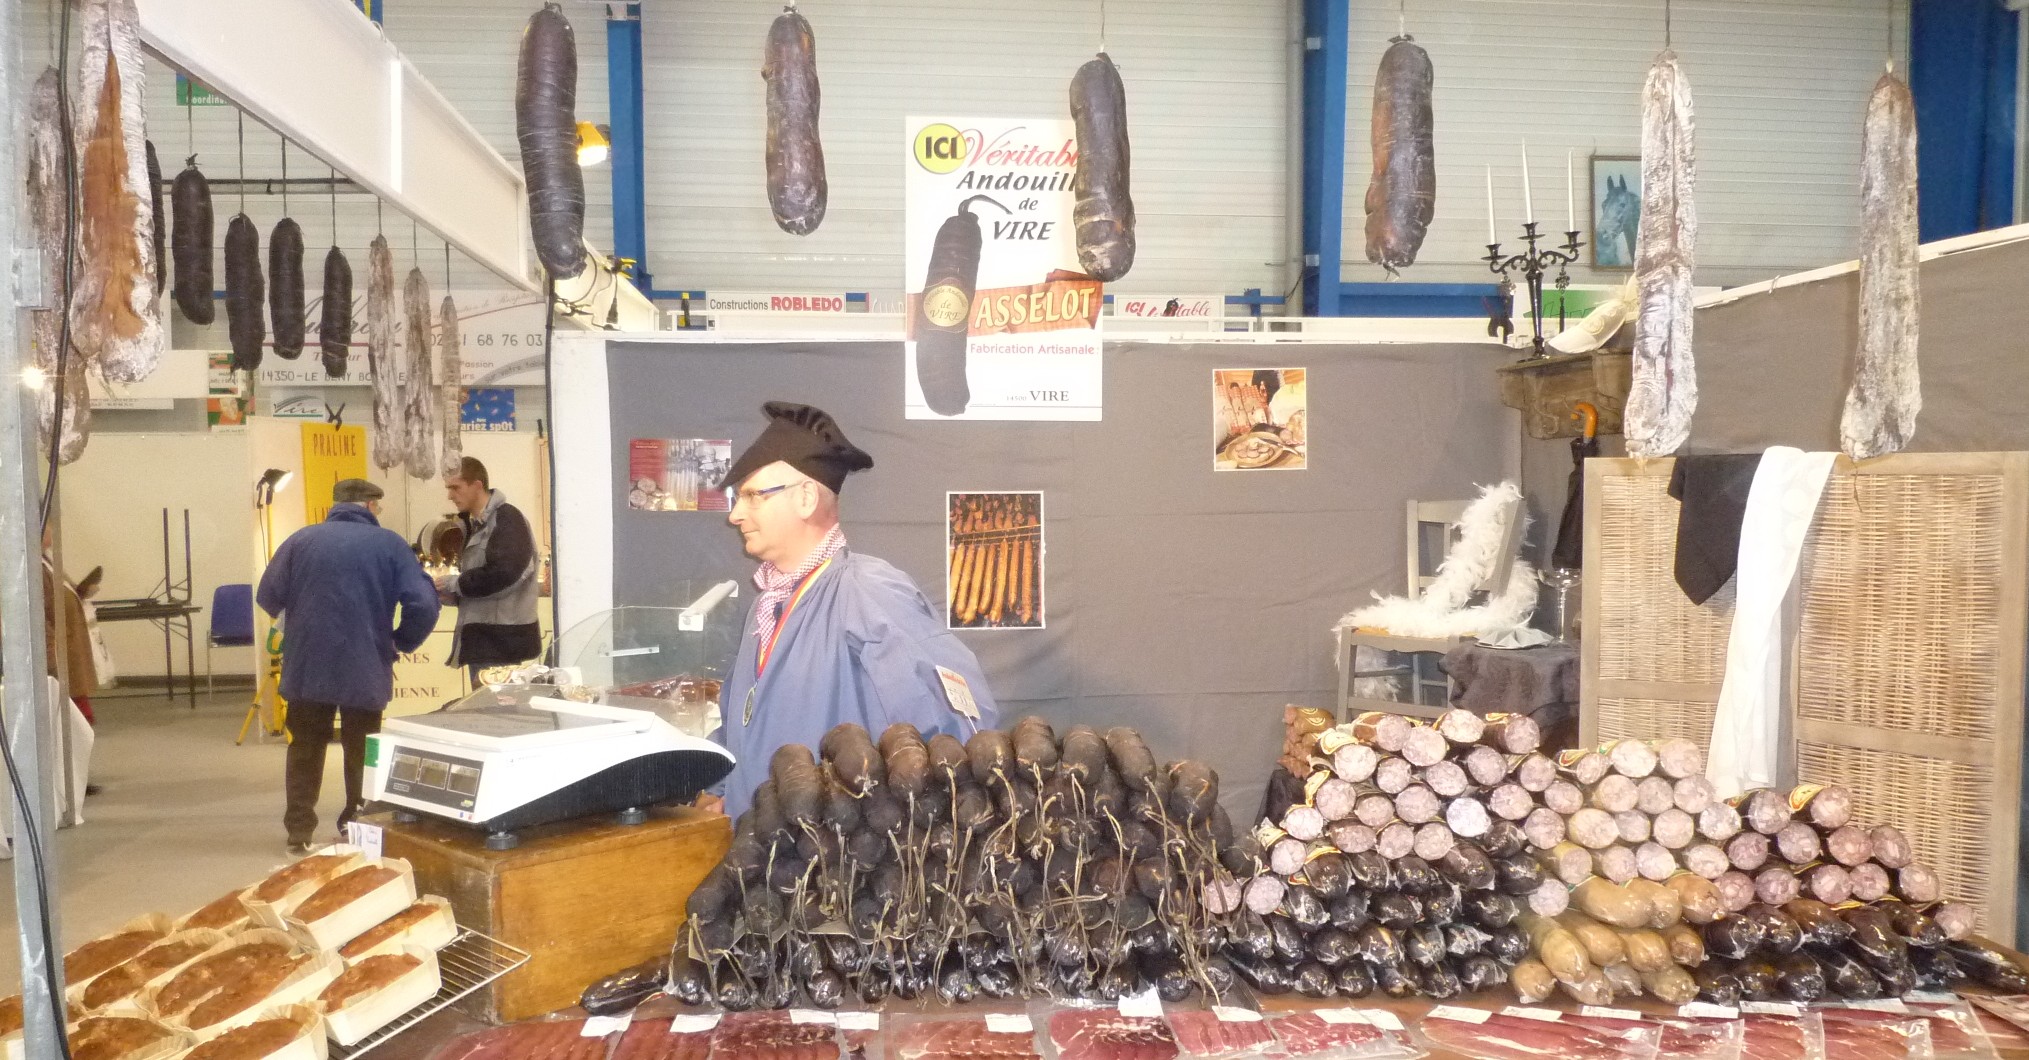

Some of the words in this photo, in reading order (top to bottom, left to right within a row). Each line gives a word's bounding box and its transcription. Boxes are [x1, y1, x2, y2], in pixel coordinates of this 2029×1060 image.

[925, 136, 958, 160] ICI
[956, 126, 1080, 168] Véritabl
[956, 170, 1076, 192] Andouill
[1018, 197, 1039, 211] de
[993, 220, 1056, 241] VIRE
[709, 298, 769, 311] Constructions
[771, 296, 843, 312] ROBLEDO
[974, 287, 1096, 329] ASSELOT
[477, 334, 494, 347] 68
[501, 333, 519, 347] 76
[526, 334, 543, 347] 03
[970, 343, 1034, 355] Fabrication
[1038, 344, 1095, 355] Artisanale
[1029, 390, 1070, 402] VIRE
[460, 420, 487, 431] ariez
[313, 433, 357, 457] PRALINE
